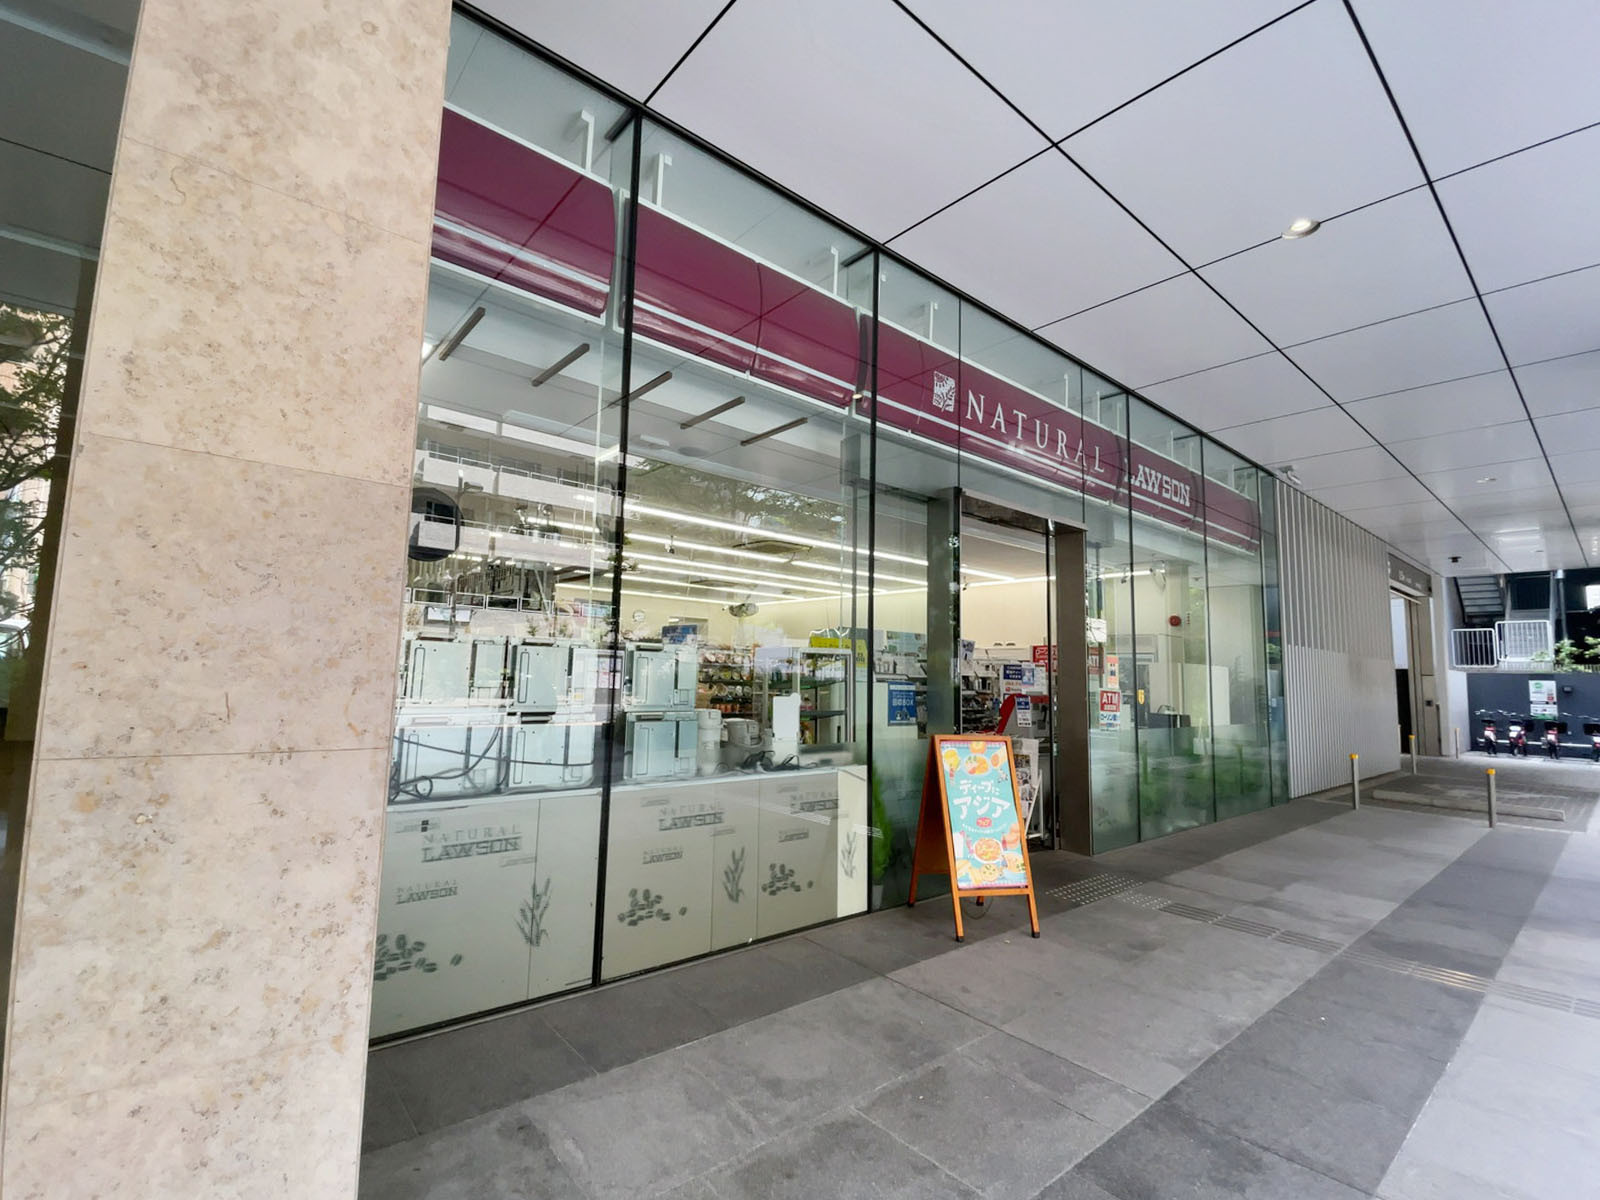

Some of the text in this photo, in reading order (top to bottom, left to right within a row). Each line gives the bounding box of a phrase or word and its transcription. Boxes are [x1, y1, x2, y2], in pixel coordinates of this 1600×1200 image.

[966, 389, 1105, 473] NATURAL
[1123, 458, 1191, 507] LAWSON
[1101, 692, 1119, 704] ATM
[959, 779, 1000, 796] ディープに
[953, 796, 1011, 820] アジア
[659, 811, 724, 831] LAWSON
[424, 824, 523, 844] NATURAL
[421, 836, 523, 863] LAWSON
[396, 886, 459, 905] LAWSON
